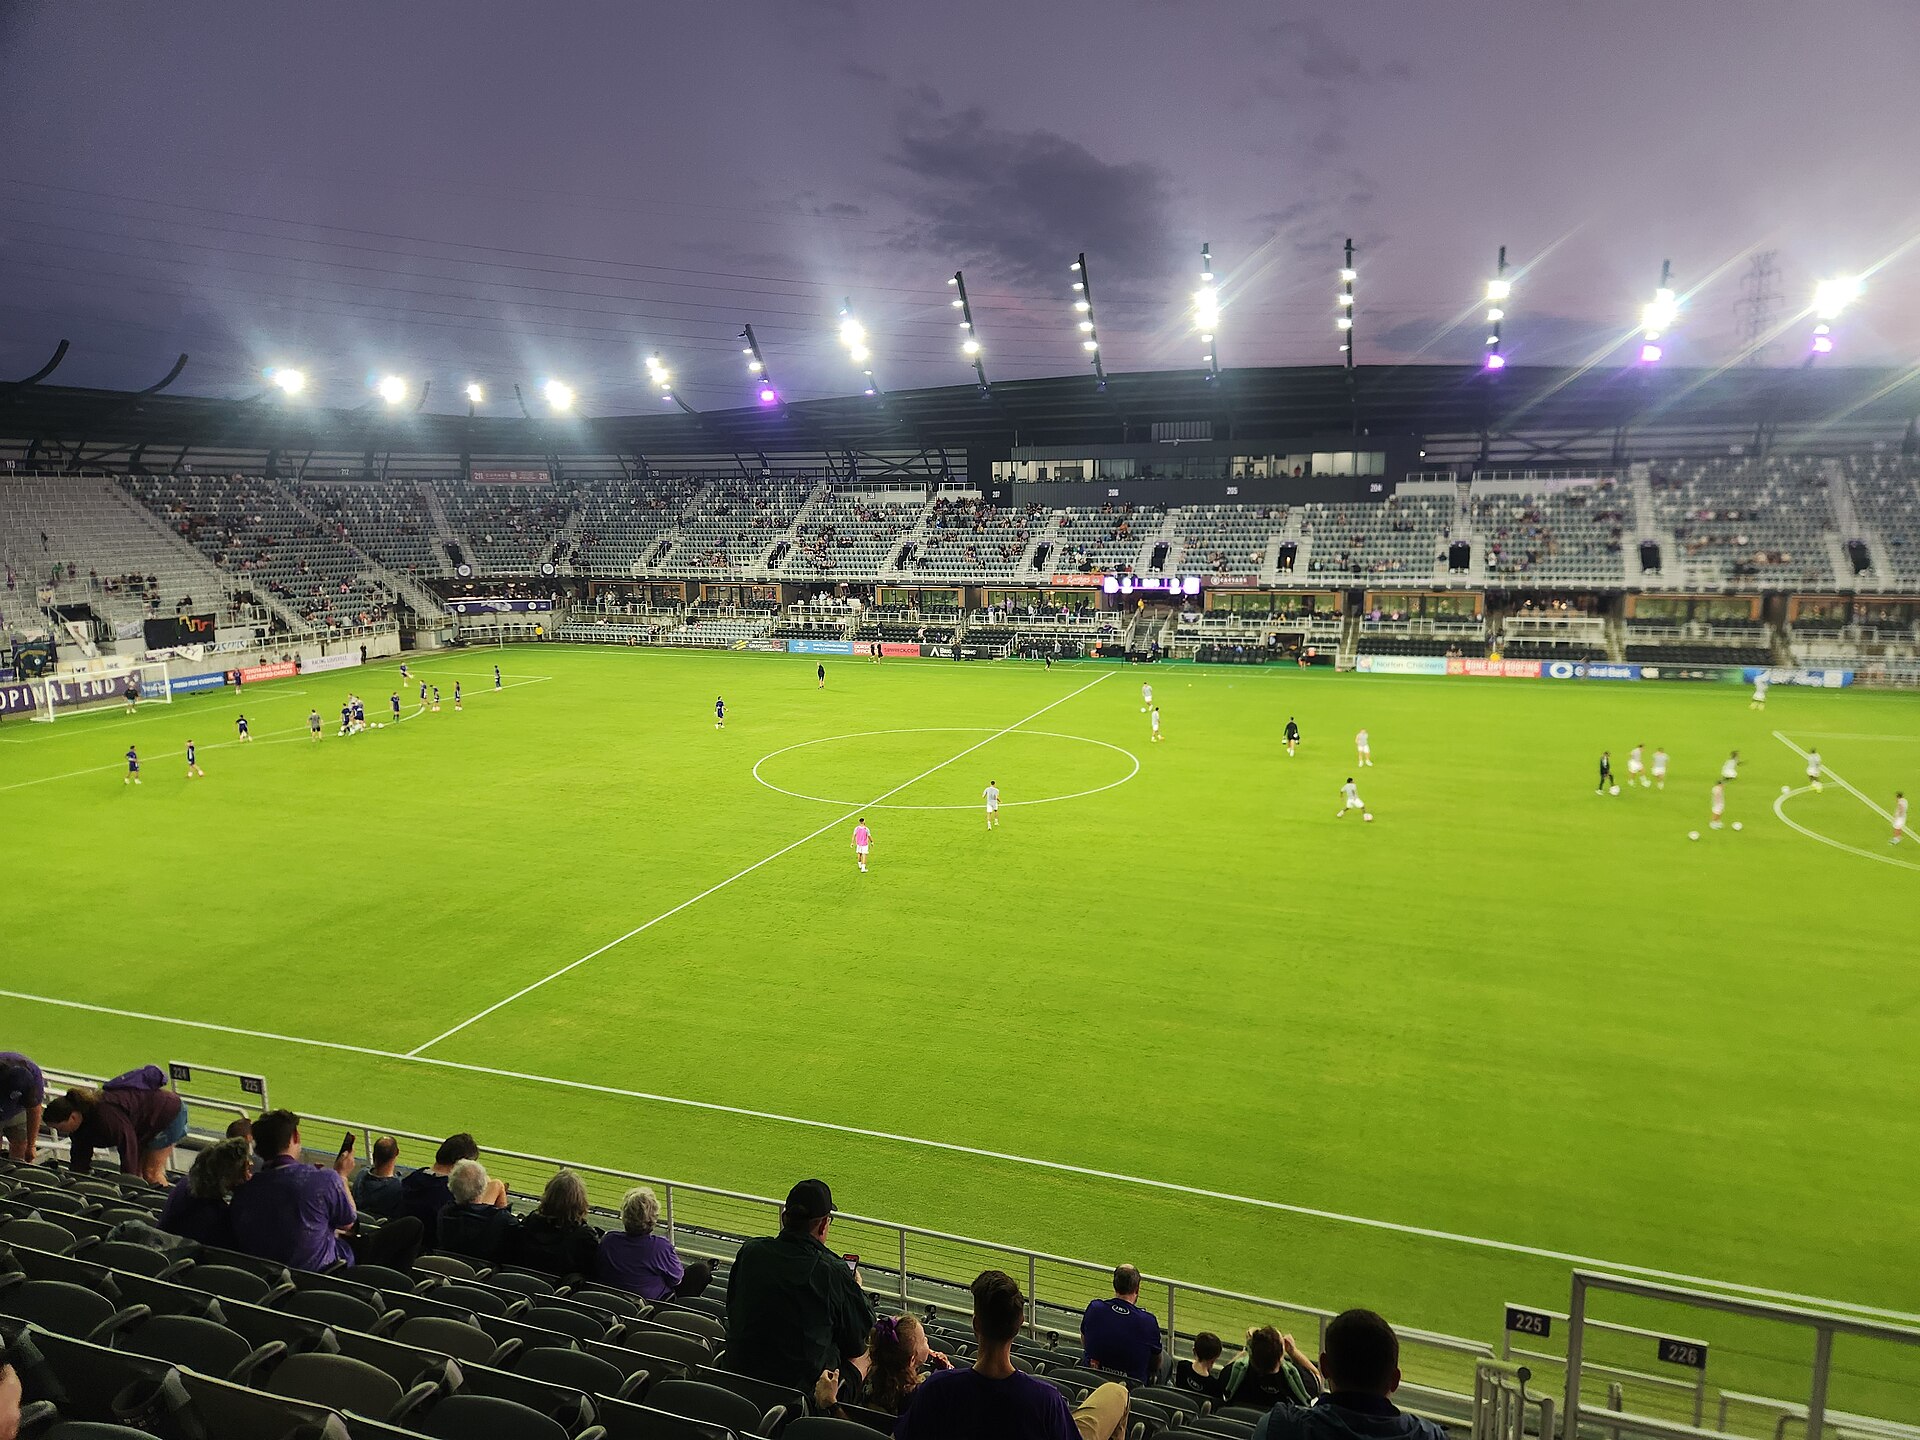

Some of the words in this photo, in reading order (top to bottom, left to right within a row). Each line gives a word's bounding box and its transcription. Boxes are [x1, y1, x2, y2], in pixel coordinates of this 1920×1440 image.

[6, 460, 15, 469] 113
[1108, 489, 1119, 497] 206
[1227, 487, 1238, 495] 205
[80, 679, 116, 698] END
[1515, 1313, 1542, 1333] 225
[1668, 1344, 1697, 1365] 226
